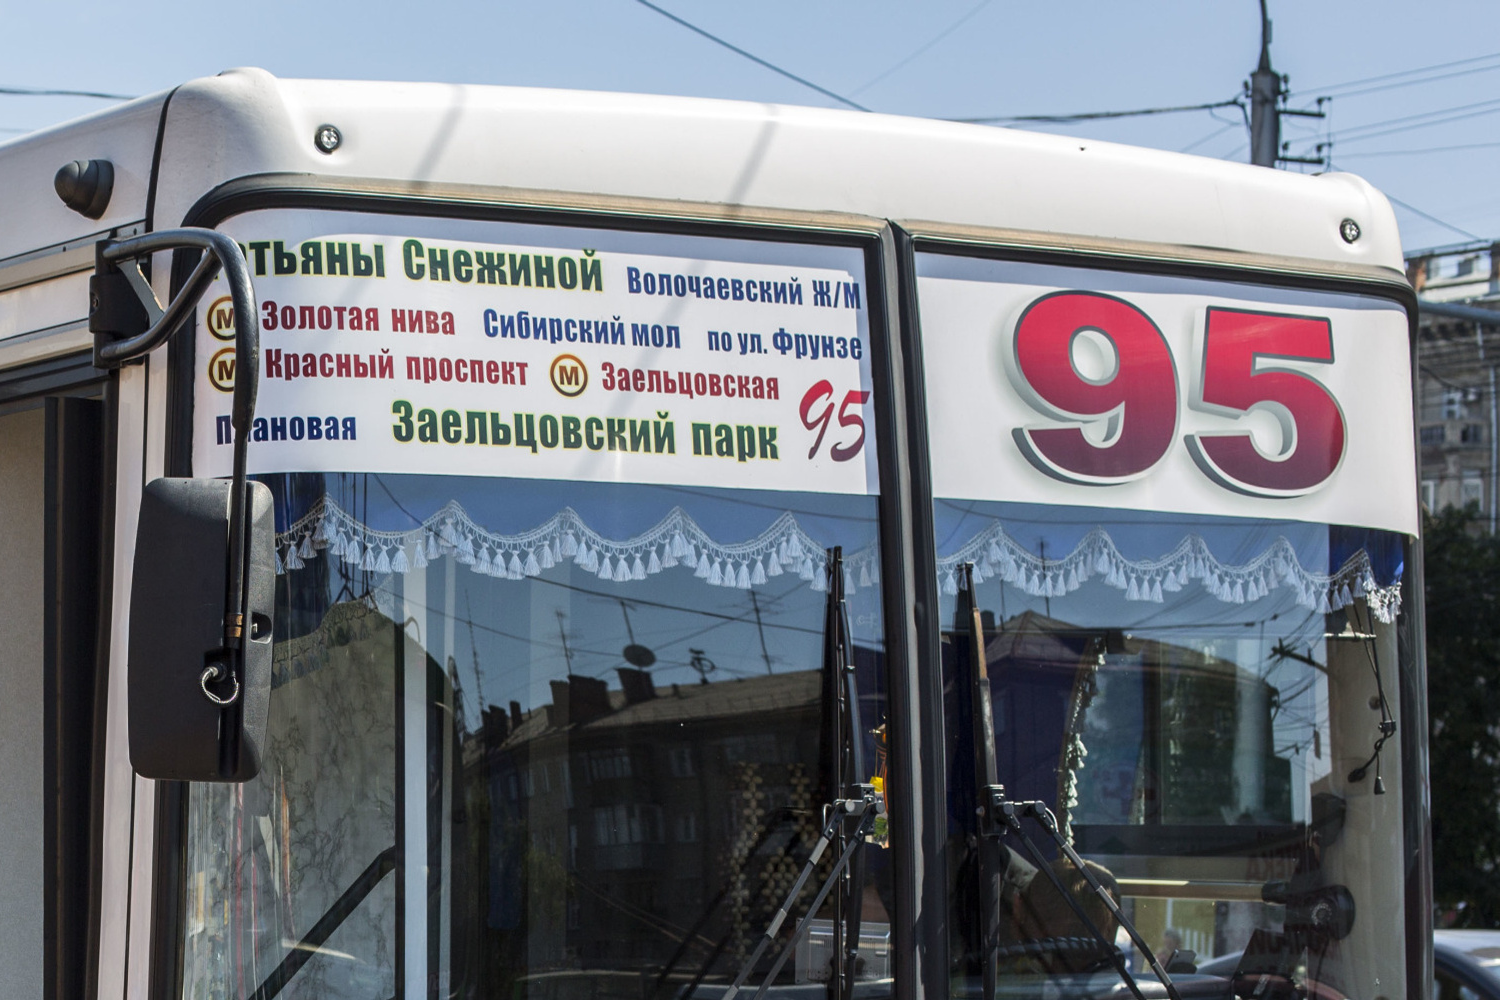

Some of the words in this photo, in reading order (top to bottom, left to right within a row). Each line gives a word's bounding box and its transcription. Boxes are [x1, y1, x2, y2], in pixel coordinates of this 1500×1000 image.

[214, 240, 387, 279] тьяны
[402, 239, 604, 292] Снежиной
[626, 266, 803, 306] Волочаевский
[812, 279, 861, 310] Ж/М
[262, 301, 379, 331] Золотая
[391, 308, 456, 335] нива
[483, 308, 626, 345] Сибирский
[631, 323, 681, 349] мол
[707, 331, 732, 352] по
[737, 332, 768, 355] ул.
[772, 327, 863, 360] Фрунзе
[265, 348, 394, 381] Красный
[406, 356, 528, 384] проспект
[601, 361, 780, 400] Заельцовская
[1004, 289, 1348, 499] 95
[216, 415, 357, 445] Пановая
[391, 399, 677, 455] Заельцовский
[691, 421, 781, 463] парк
[799, 379, 871, 463] 95
